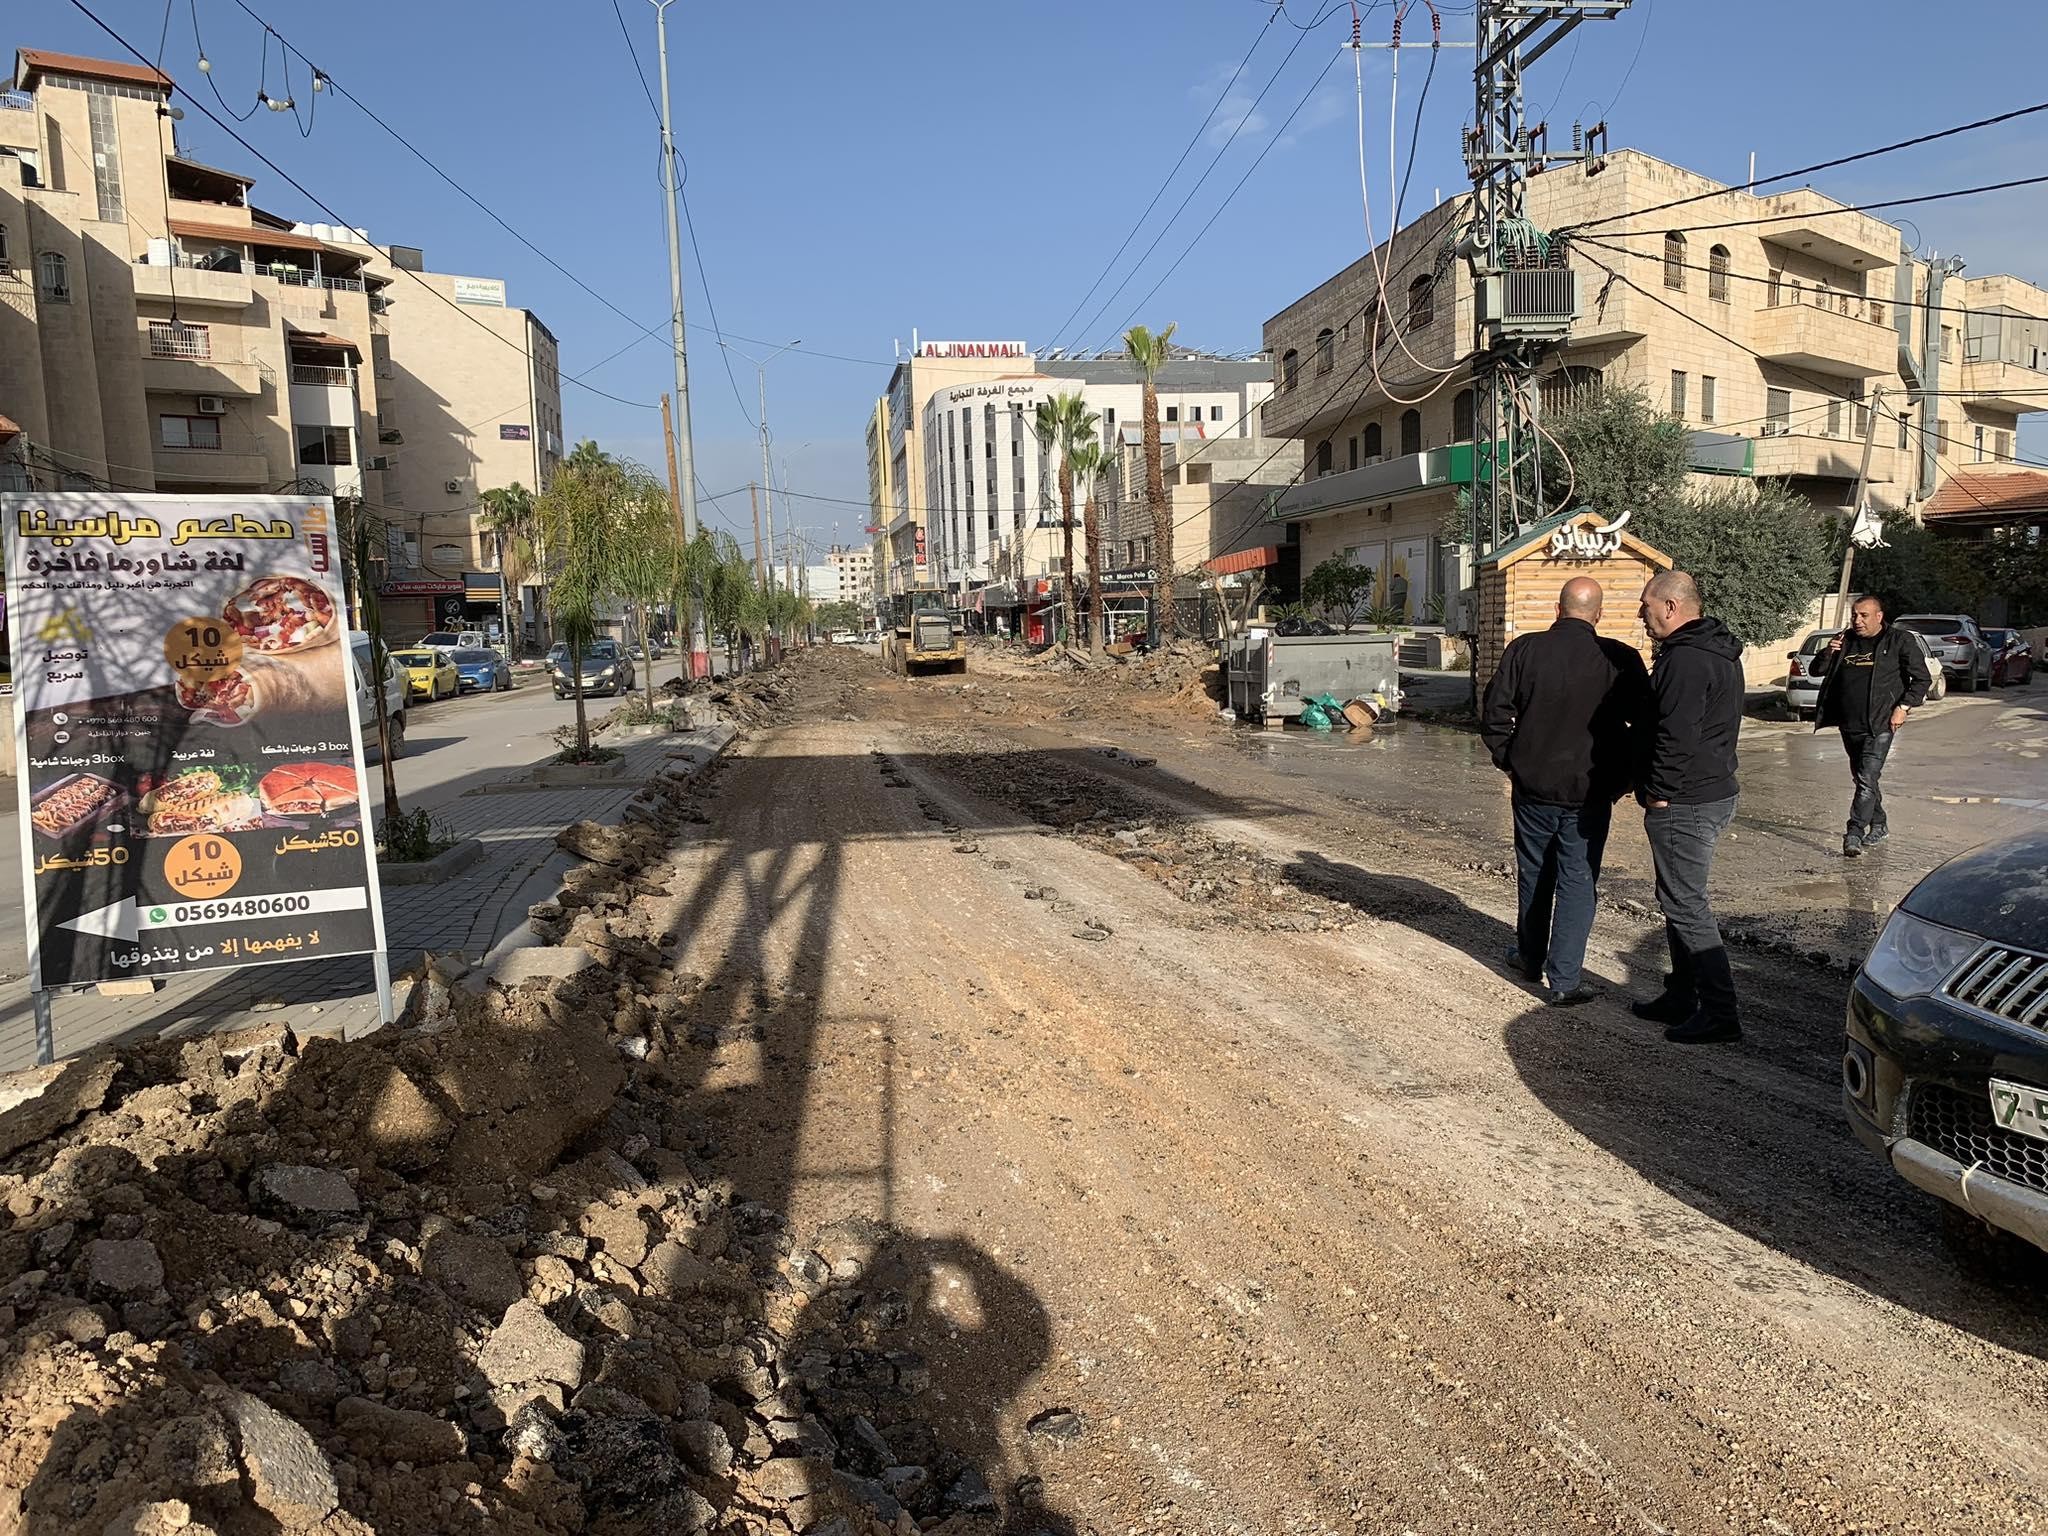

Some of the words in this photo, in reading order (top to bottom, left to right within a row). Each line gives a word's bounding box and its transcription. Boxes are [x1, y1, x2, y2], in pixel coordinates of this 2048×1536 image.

[926, 344, 941, 357] AL
[944, 344, 985, 357] JINAN
[989, 344, 1024, 357] MALL
[950, 388, 975, 403] التجارية
[977, 385, 1005, 398] الغرفة
[1007, 385, 1034, 397] مجمع
[17, 509, 162, 547] مراسينا
[170, 513, 295, 547] مطعم
[27, 550, 100, 577] فاخرة
[107, 551, 197, 576] شاورما
[204, 551, 245, 571] لفة
[21, 581, 50, 591] الحكم
[52, 583, 65, 591] هو
[67, 580, 101, 591] ومذاقك
[104, 581, 124, 591] دليل
[126, 579, 145, 590] أكبر
[147, 580, 161, 592] هي
[163, 580, 194, 589] التجربة
[185, 627, 221, 647] 10
[42, 650, 88, 663] توصيل
[176, 650, 229, 671] شيكل
[47, 671, 83, 683] سريع
[141, 715, 158, 723] 600
[134, 729, 151, 737] جنين
[200, 748, 215, 758] لفة
[290, 744, 317, 754] وجبات
[329, 742, 349, 751] box
[60, 756, 90, 767] وجبات
[172, 750, 198, 761] عربية
[30, 756, 59, 769] شامية
[188, 840, 222, 861] 10
[175, 862, 233, 886] شيكل
[175, 895, 310, 923] 0569480600
[243, 932, 303, 954] يفهمها
[308, 930, 321, 945] لا
[185, 945, 215, 962] من
[220, 938, 240, 958] إلا
[110, 945, 180, 969] يتذوقها
